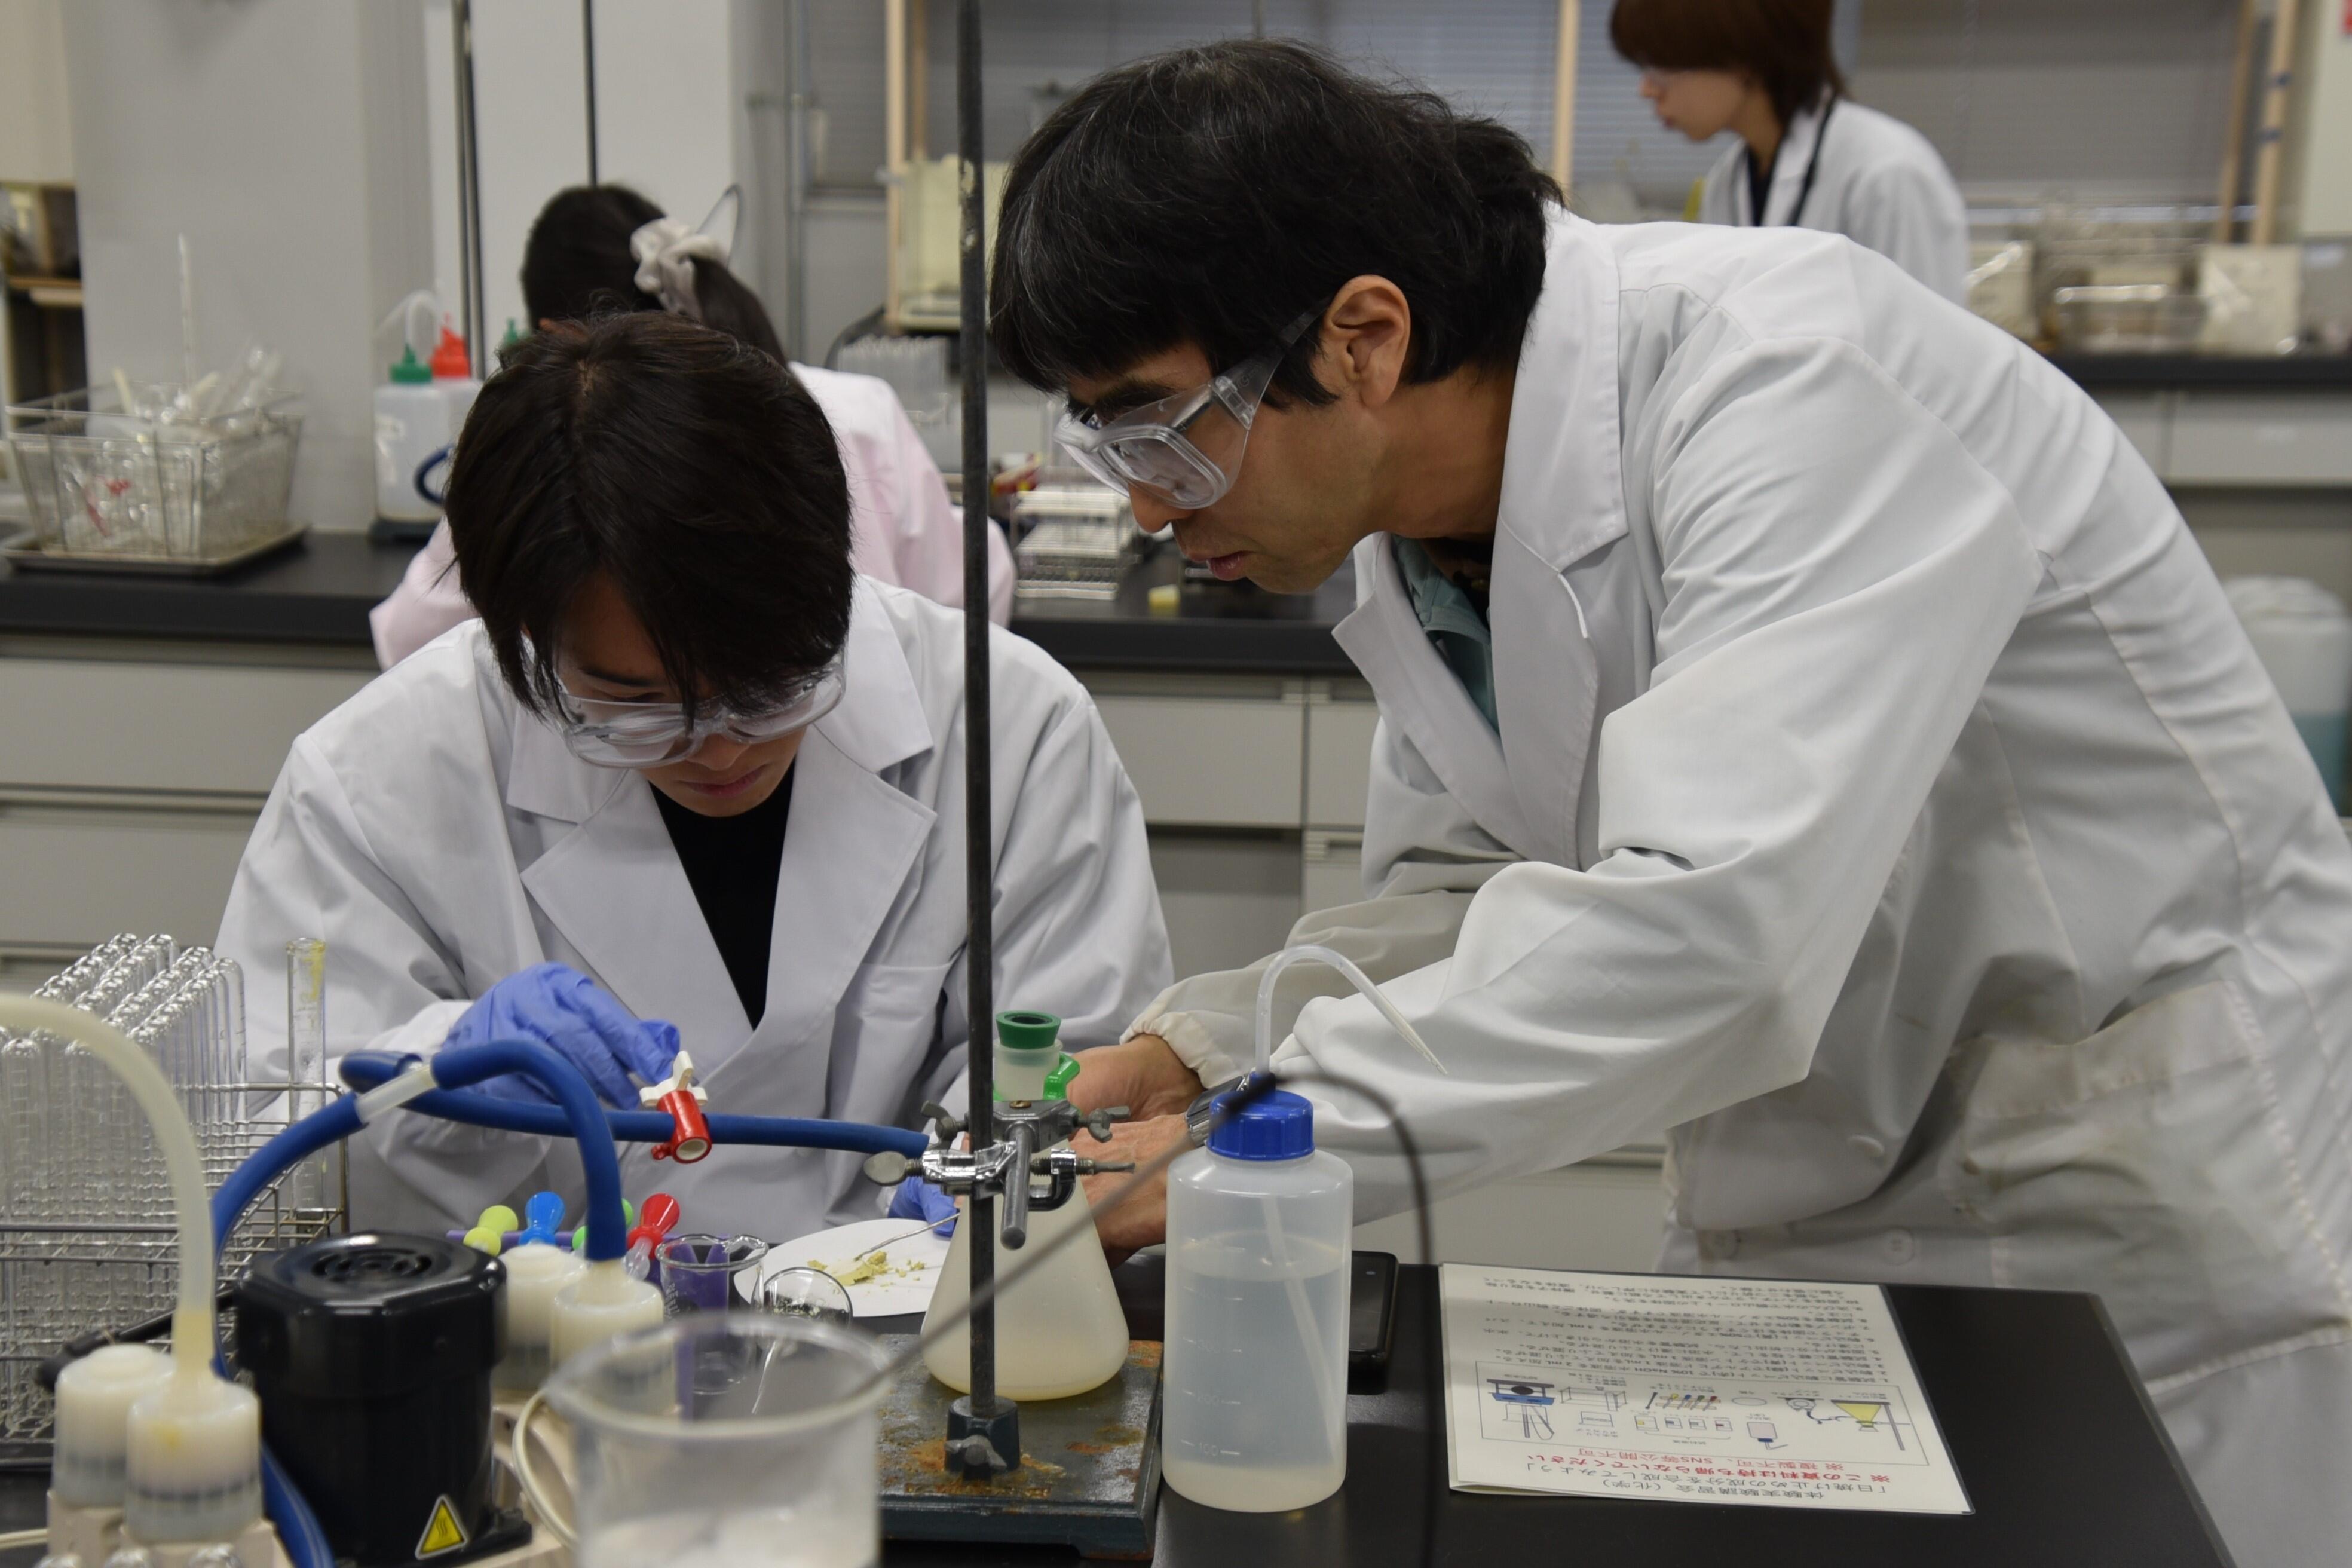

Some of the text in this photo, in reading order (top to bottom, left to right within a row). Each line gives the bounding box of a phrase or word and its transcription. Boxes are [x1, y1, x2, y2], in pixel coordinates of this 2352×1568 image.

[1529, 1455, 1860, 1481] この資料は持ち帰らないでください
[1579, 1448, 1818, 1470] 複製不可、SNS等公開不可
[1527, 1463, 1885, 1493] 「日焼け止めの成分を合成してみよう」
[1603, 1479, 1823, 1499] 体験実験講習会（化学）
